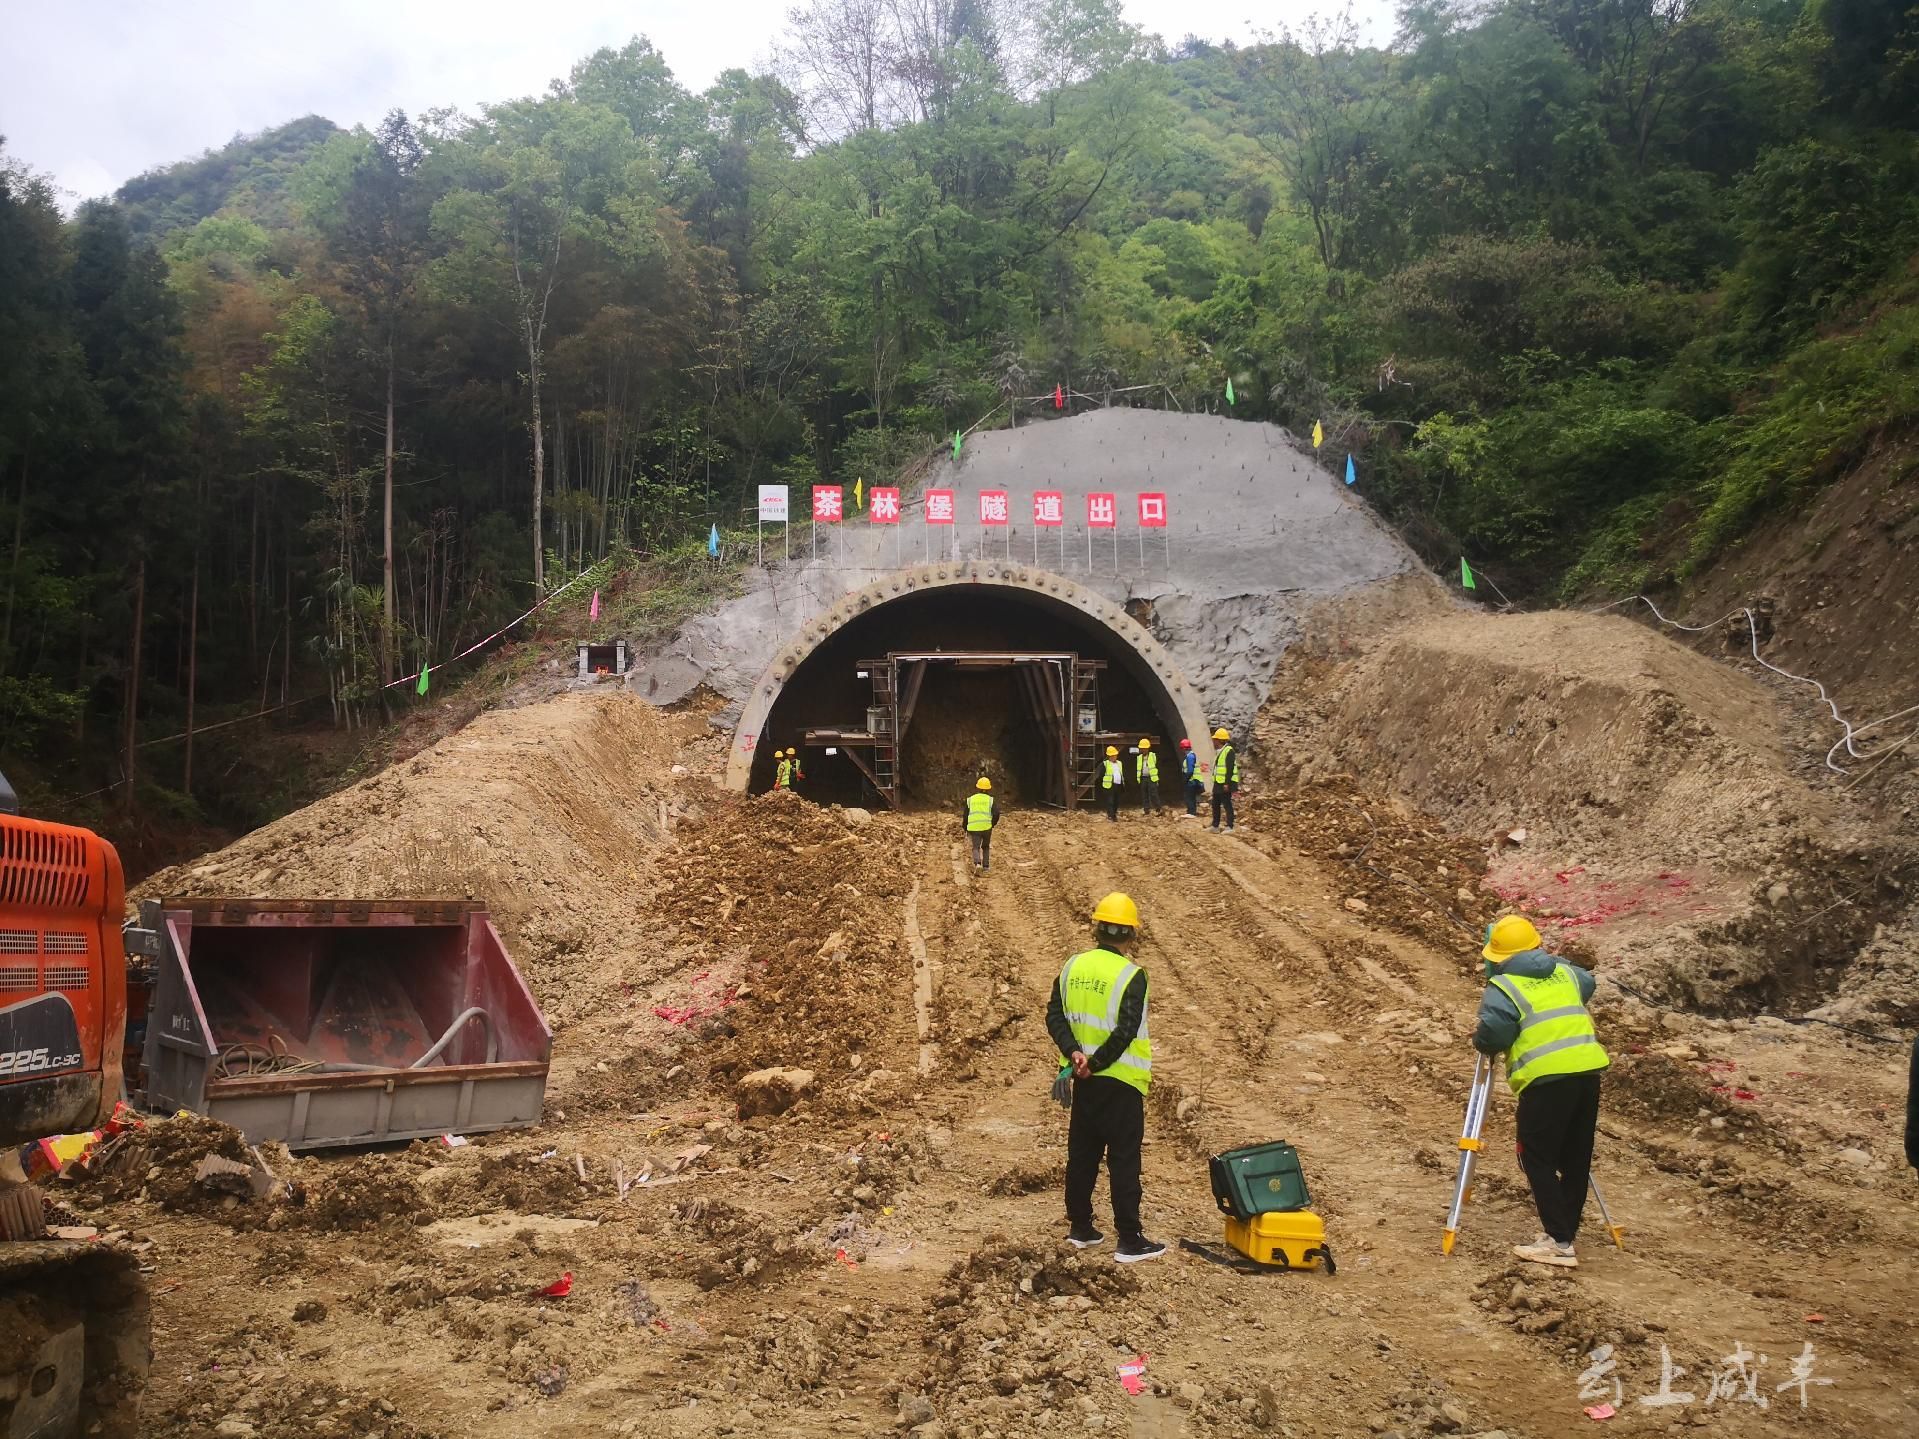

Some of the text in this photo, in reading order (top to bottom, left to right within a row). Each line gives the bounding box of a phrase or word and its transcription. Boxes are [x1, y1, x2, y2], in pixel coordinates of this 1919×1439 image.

[815, 489, 1164, 522] 茶林堡隧道出口
